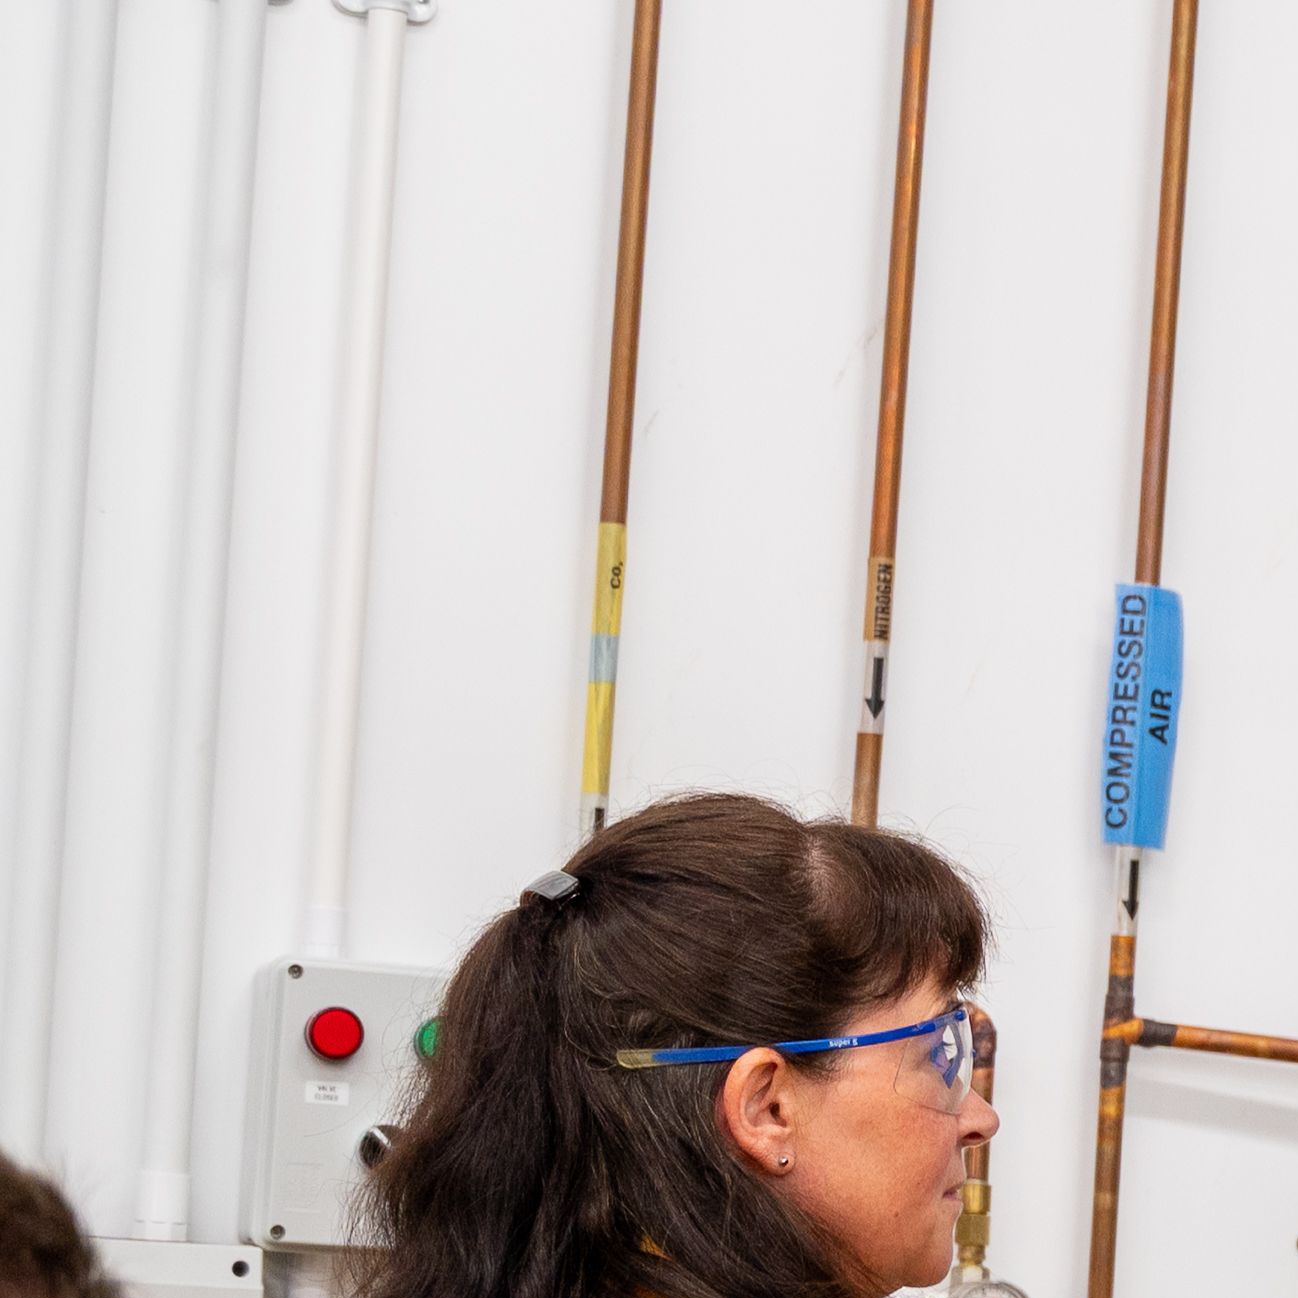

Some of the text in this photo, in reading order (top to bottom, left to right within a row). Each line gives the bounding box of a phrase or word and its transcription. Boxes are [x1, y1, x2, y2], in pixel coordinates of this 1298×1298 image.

[874, 563, 893, 641] NITROGEN
[1104, 593, 1147, 830] COMPRESSED
[1148, 687, 1172, 745] AIR
